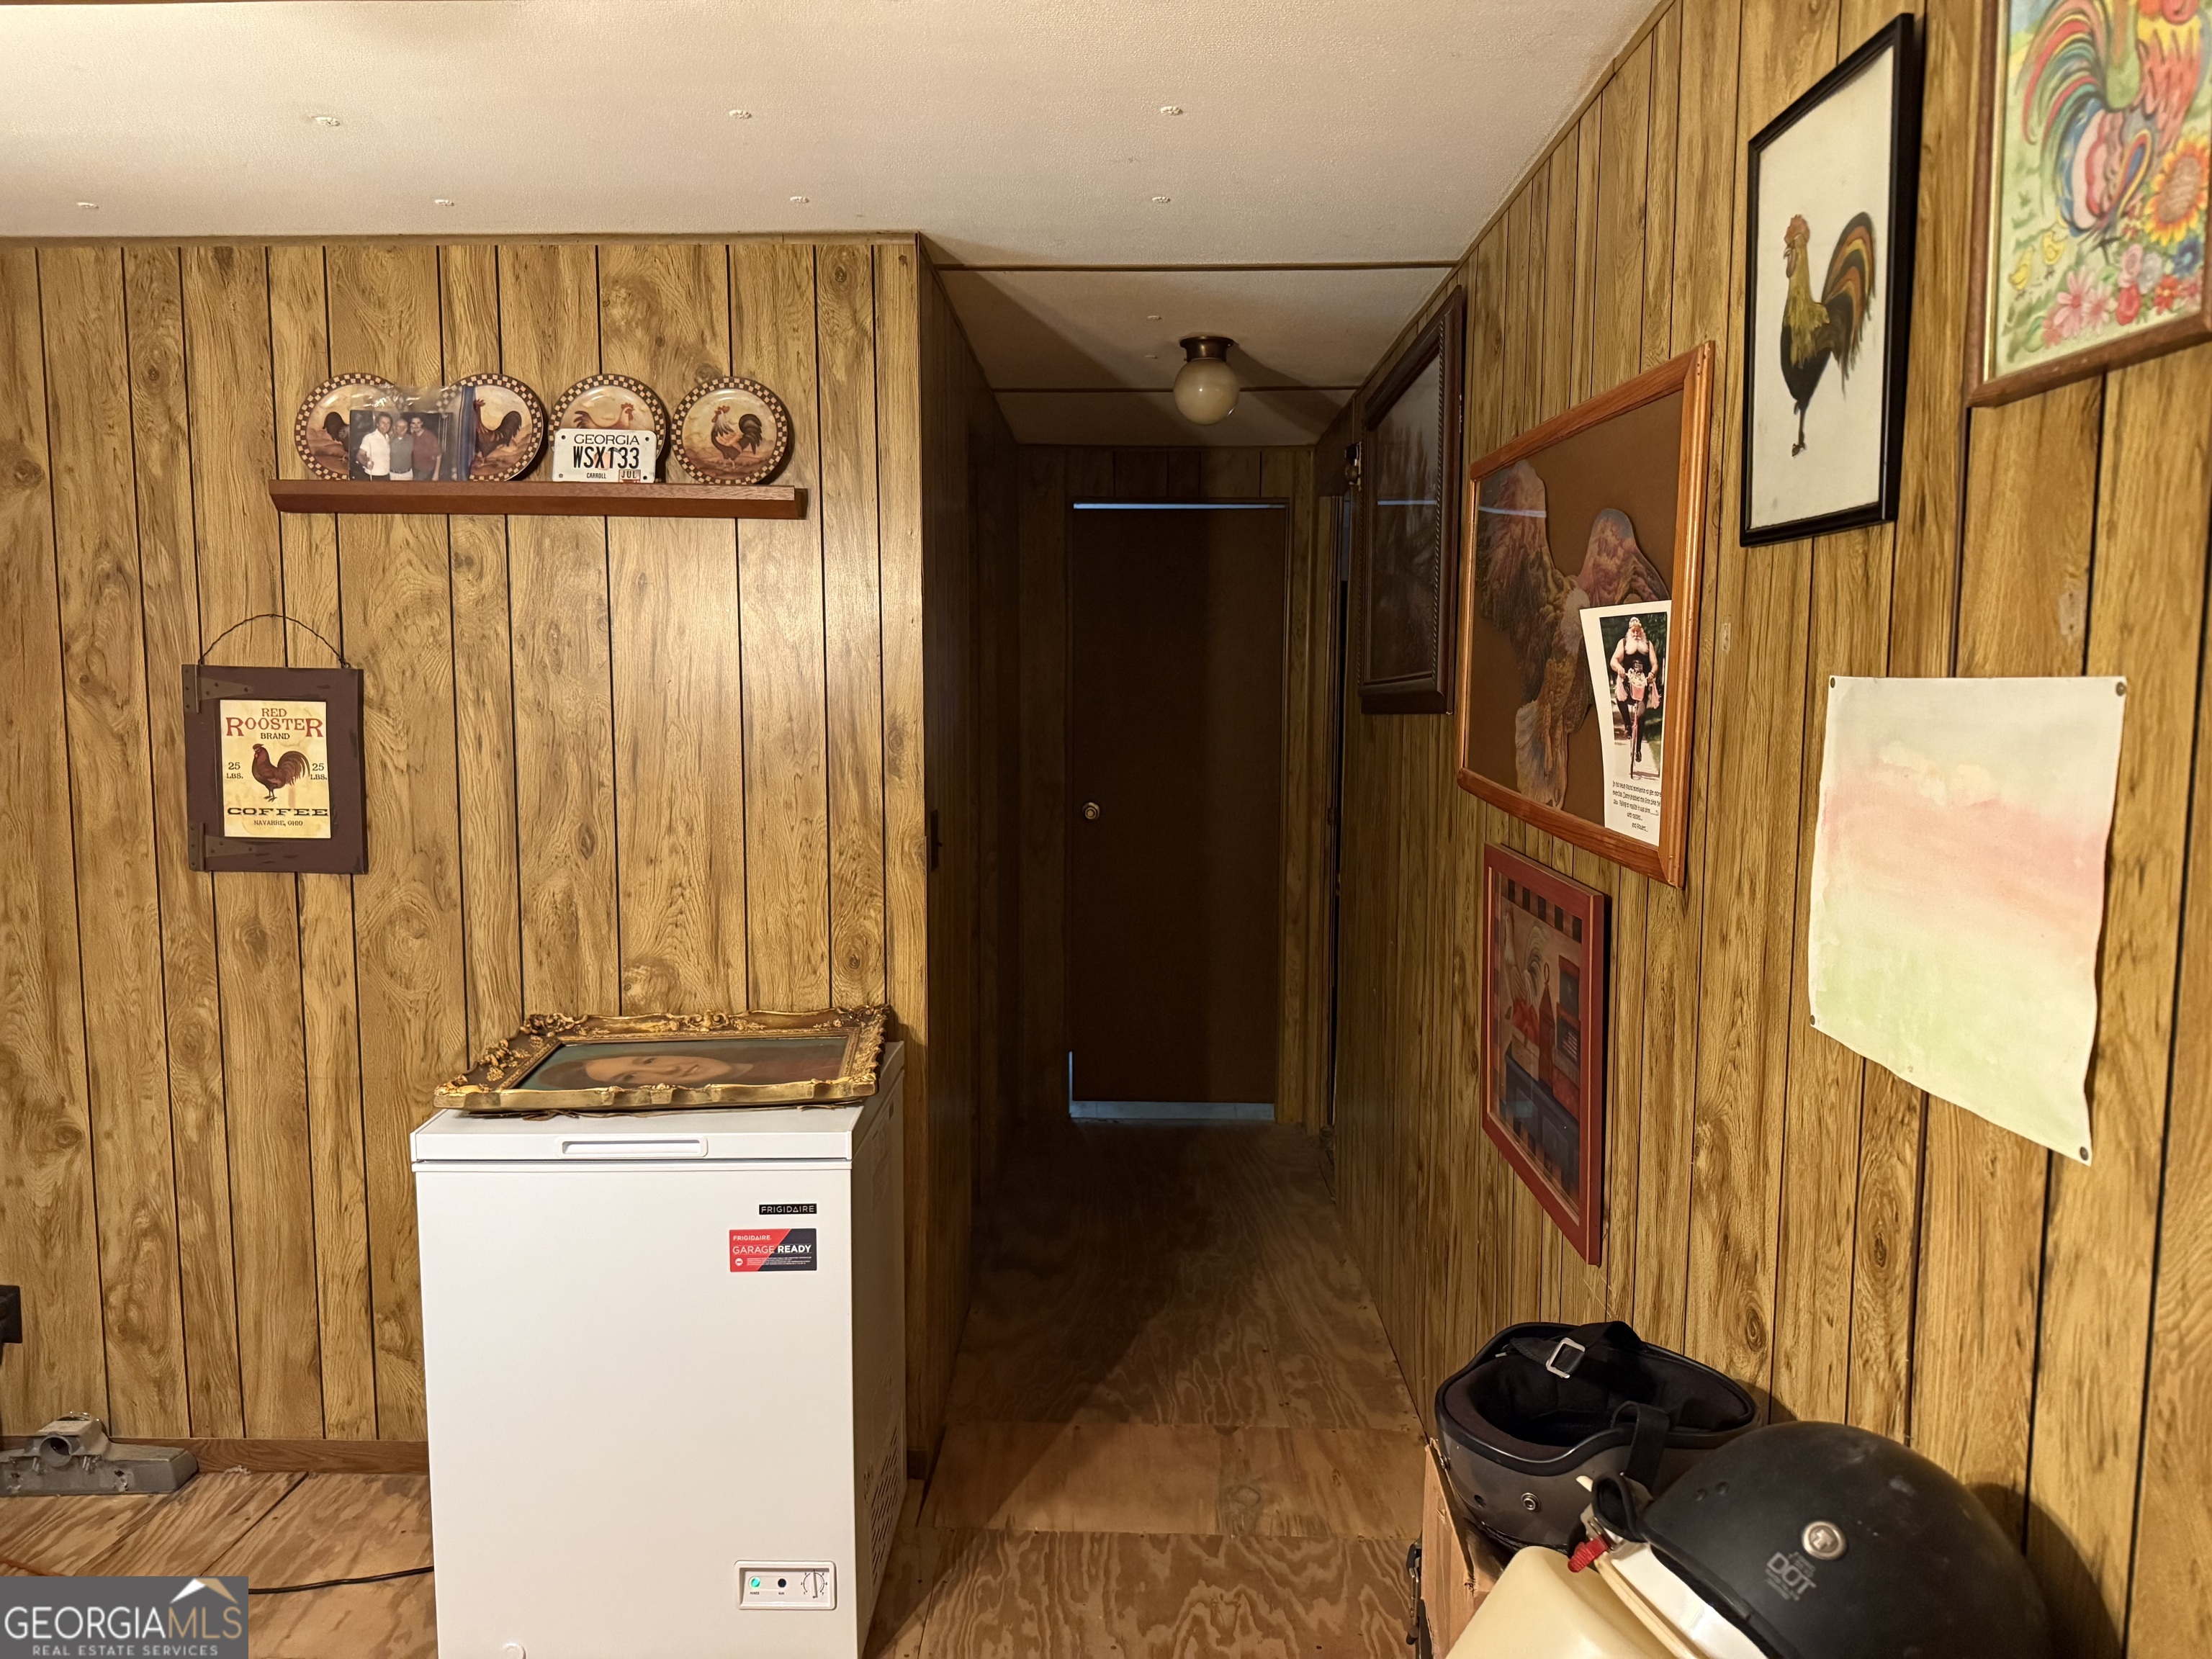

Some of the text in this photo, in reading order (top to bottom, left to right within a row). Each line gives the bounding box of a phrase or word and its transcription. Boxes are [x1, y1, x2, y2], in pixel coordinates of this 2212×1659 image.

[574, 433, 640, 445] GEORGIA
[572, 446, 639, 469] WSX133
[261, 708, 287, 717] RED
[225, 717, 323, 737] ROOSTER
[228, 762, 240, 770] 25
[227, 807, 329, 817] COFFEE
[732, 1244, 811, 1254] GARAGE READY
[1766, 1552, 1817, 1594] DOT
